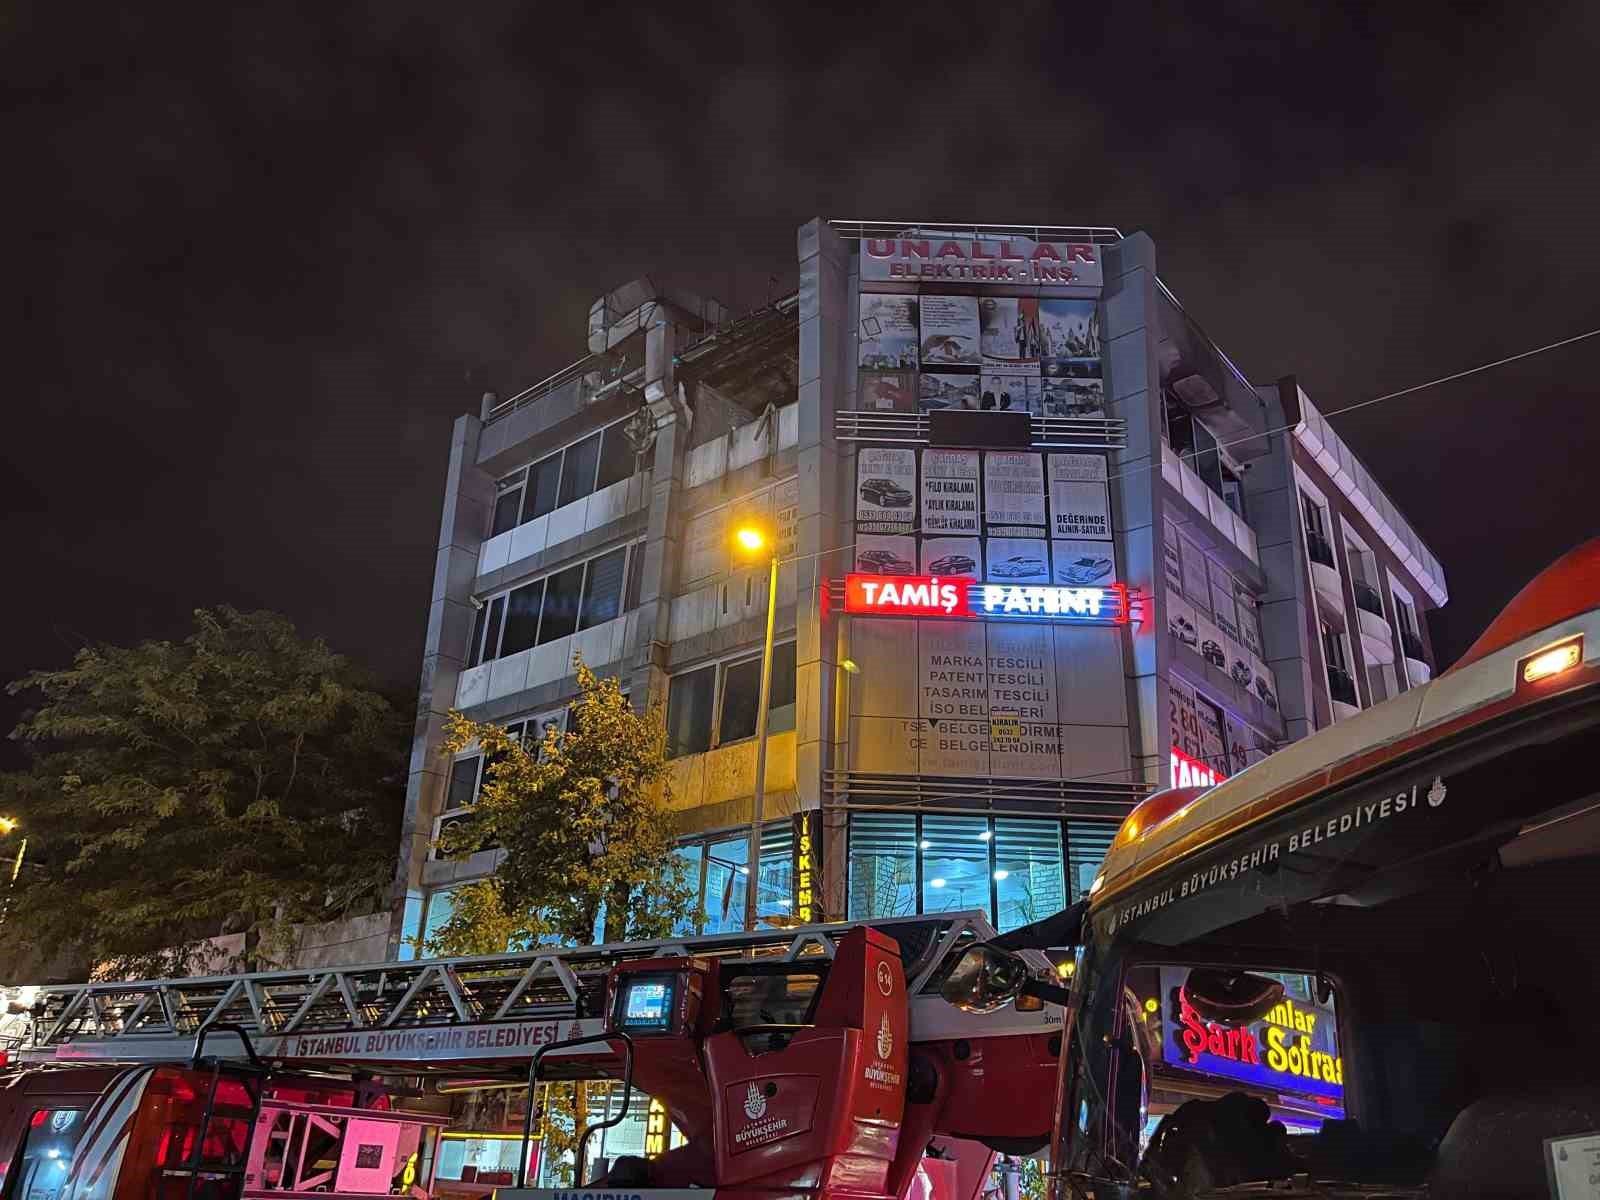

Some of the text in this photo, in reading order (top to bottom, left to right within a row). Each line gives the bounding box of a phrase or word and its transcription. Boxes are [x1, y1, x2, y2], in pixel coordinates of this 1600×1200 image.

[889, 260, 1014, 281] ELEKTRİK
[1056, 512, 1106, 525] DEĞERİNDE
[861, 577, 1104, 617] TAMİŞ PATENT
[931, 655, 1044, 671] MARKA TESCİLİ
[929, 671, 1045, 686] PATENT TESCİLİ
[924, 687, 1050, 702] TASARIM TESCİLİ
[929, 702, 955, 715] İSO
[902, 720, 1065, 738] TSE BELGEDİRME
[1119, 785, 1418, 927] İSTANBUL BÜYÜKŞEHİR BELEDİYESİ
[1179, 986, 1260, 1066] Şark
[294, 1021, 560, 1057] İSTANBUL BÜYÜKŞEHİR BELEDİYESİ
[735, 1118, 788, 1143] BÜYÜKŞEHİR
